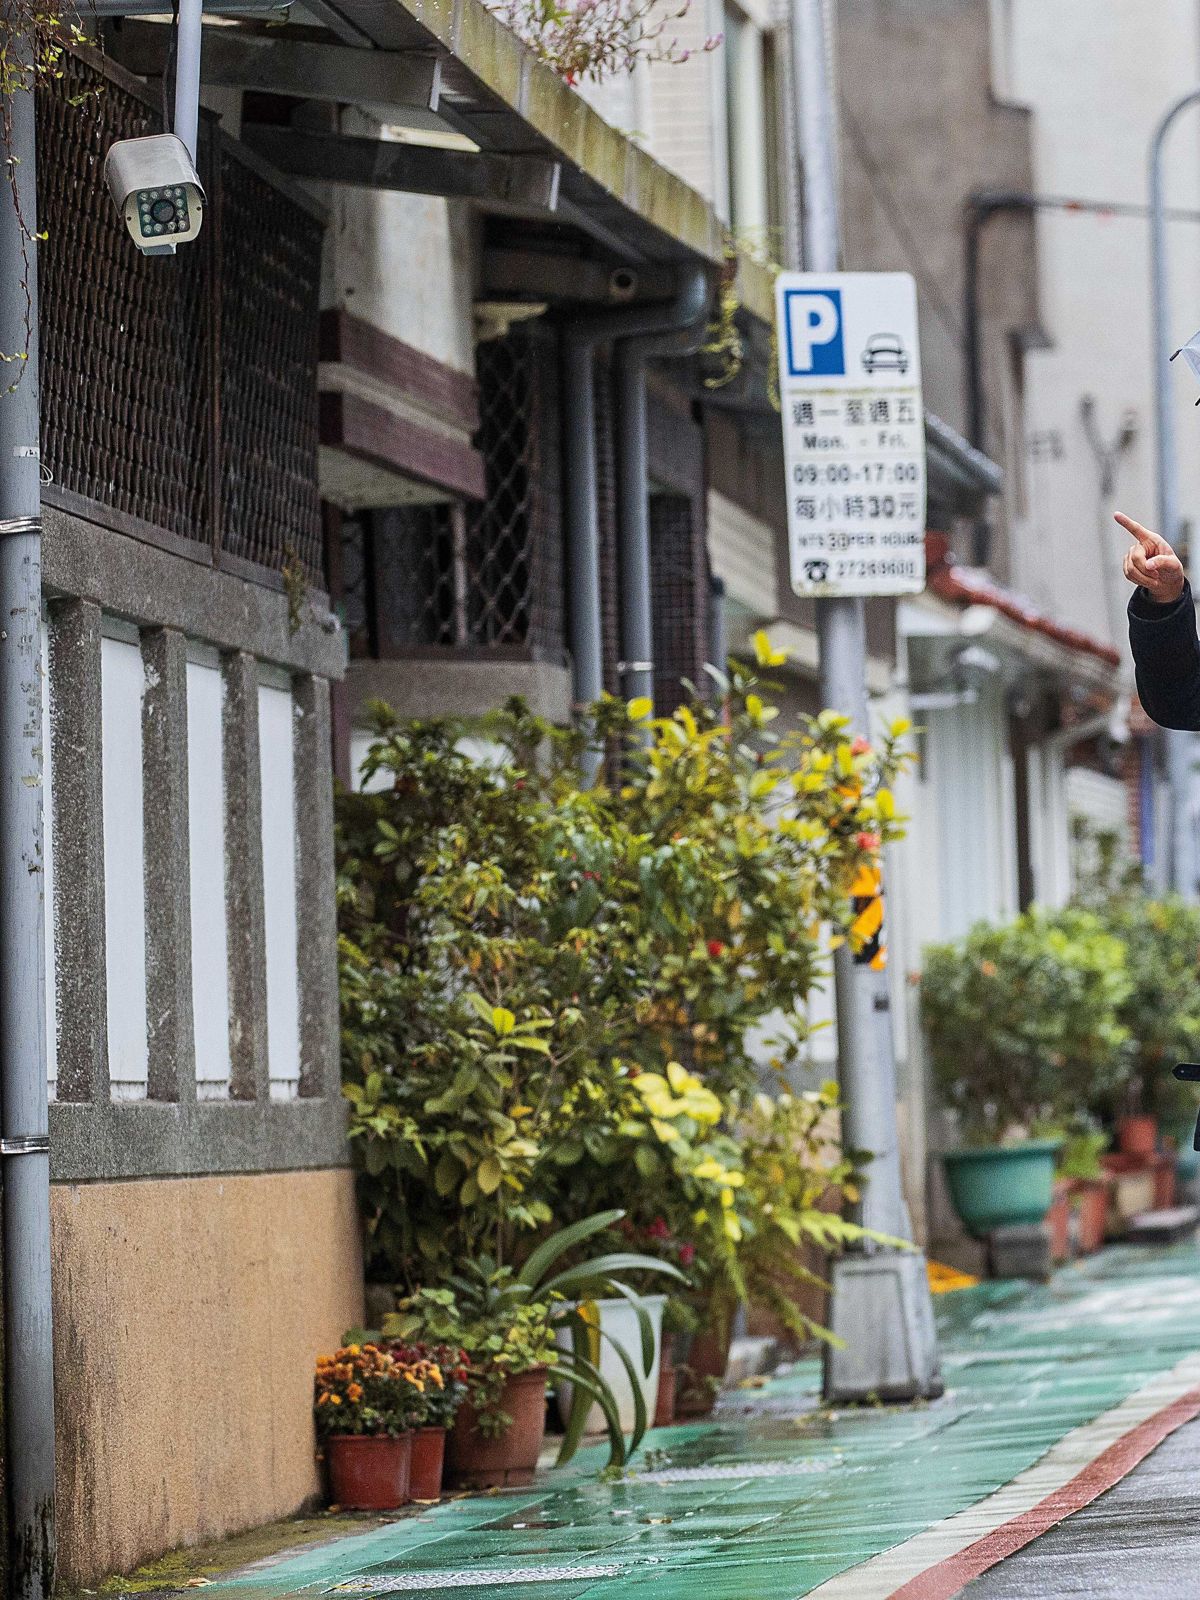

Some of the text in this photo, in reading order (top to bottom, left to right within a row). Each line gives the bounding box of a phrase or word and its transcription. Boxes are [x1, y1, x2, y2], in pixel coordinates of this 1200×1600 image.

[788, 293, 839, 372] P
[793, 399, 916, 426] 週一至週五
[803, 432, 844, 449] Mon.
[794, 462, 917, 485] 09:00-17:00
[795, 493, 918, 520] 每小時30元
